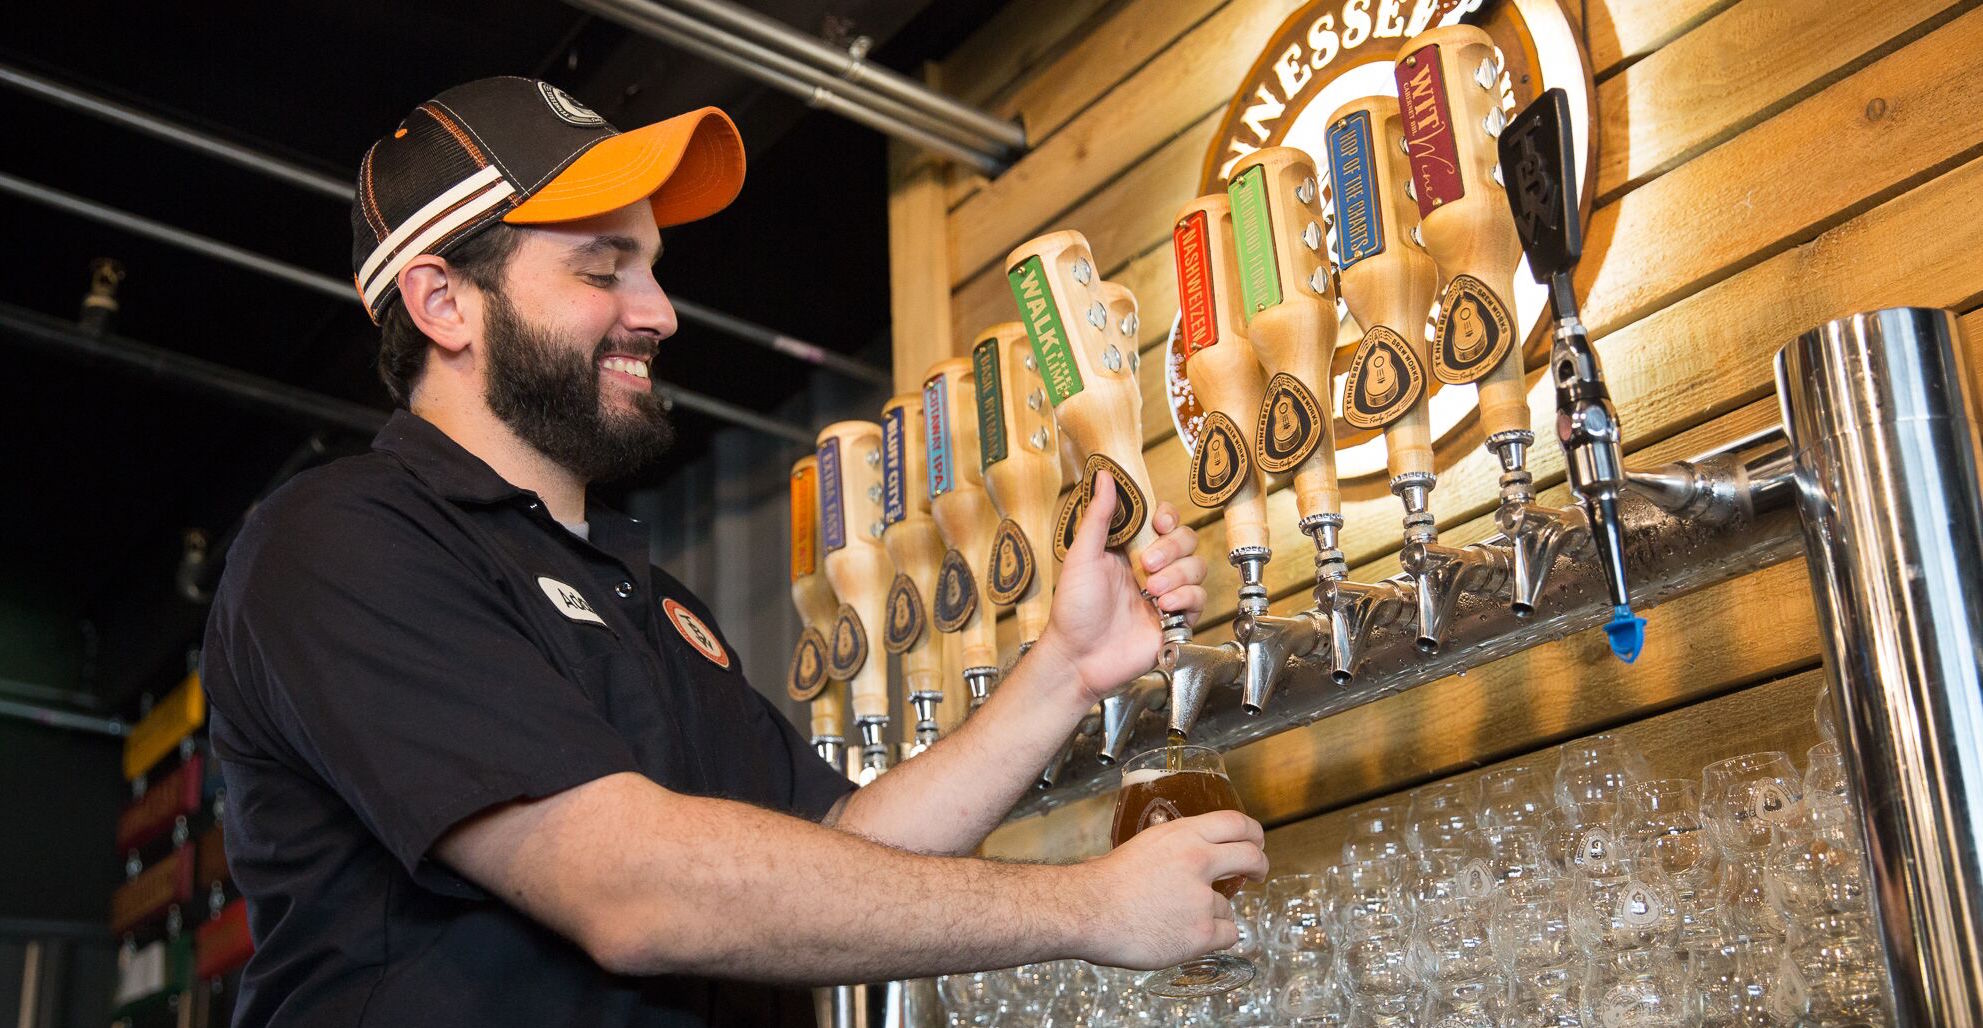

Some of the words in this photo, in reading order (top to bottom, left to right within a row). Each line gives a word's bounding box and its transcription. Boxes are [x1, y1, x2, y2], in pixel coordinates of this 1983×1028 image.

[1409, 64, 1440, 131] WIT
[1339, 129, 1359, 158] HOP
[1342, 156, 1362, 176] OF
[1409, 121, 1454, 200] Wine
[1344, 175, 1364, 202] THE
[1347, 201, 1369, 251] CHARTS
[1182, 228, 1207, 342] NASHWEIZEN
[1020, 268, 1060, 355] WALK
[1477, 287, 1493, 307] BREW
[1492, 304, 1508, 335] WORKS
[1435, 307, 1449, 367] TENNESSEE
[1045, 352, 1068, 395] LIME
[1346, 354, 1363, 411] TENNESSEE
[1391, 338, 1407, 356] BREW
[1405, 353, 1420, 383] WORKS
[1304, 399, 1319, 426] WORKS
[887, 417, 899, 468] BLUFF
[888, 469, 900, 507] CITY
[933, 454, 944, 489] IPA
[1123, 480, 1140, 507] WORKS
